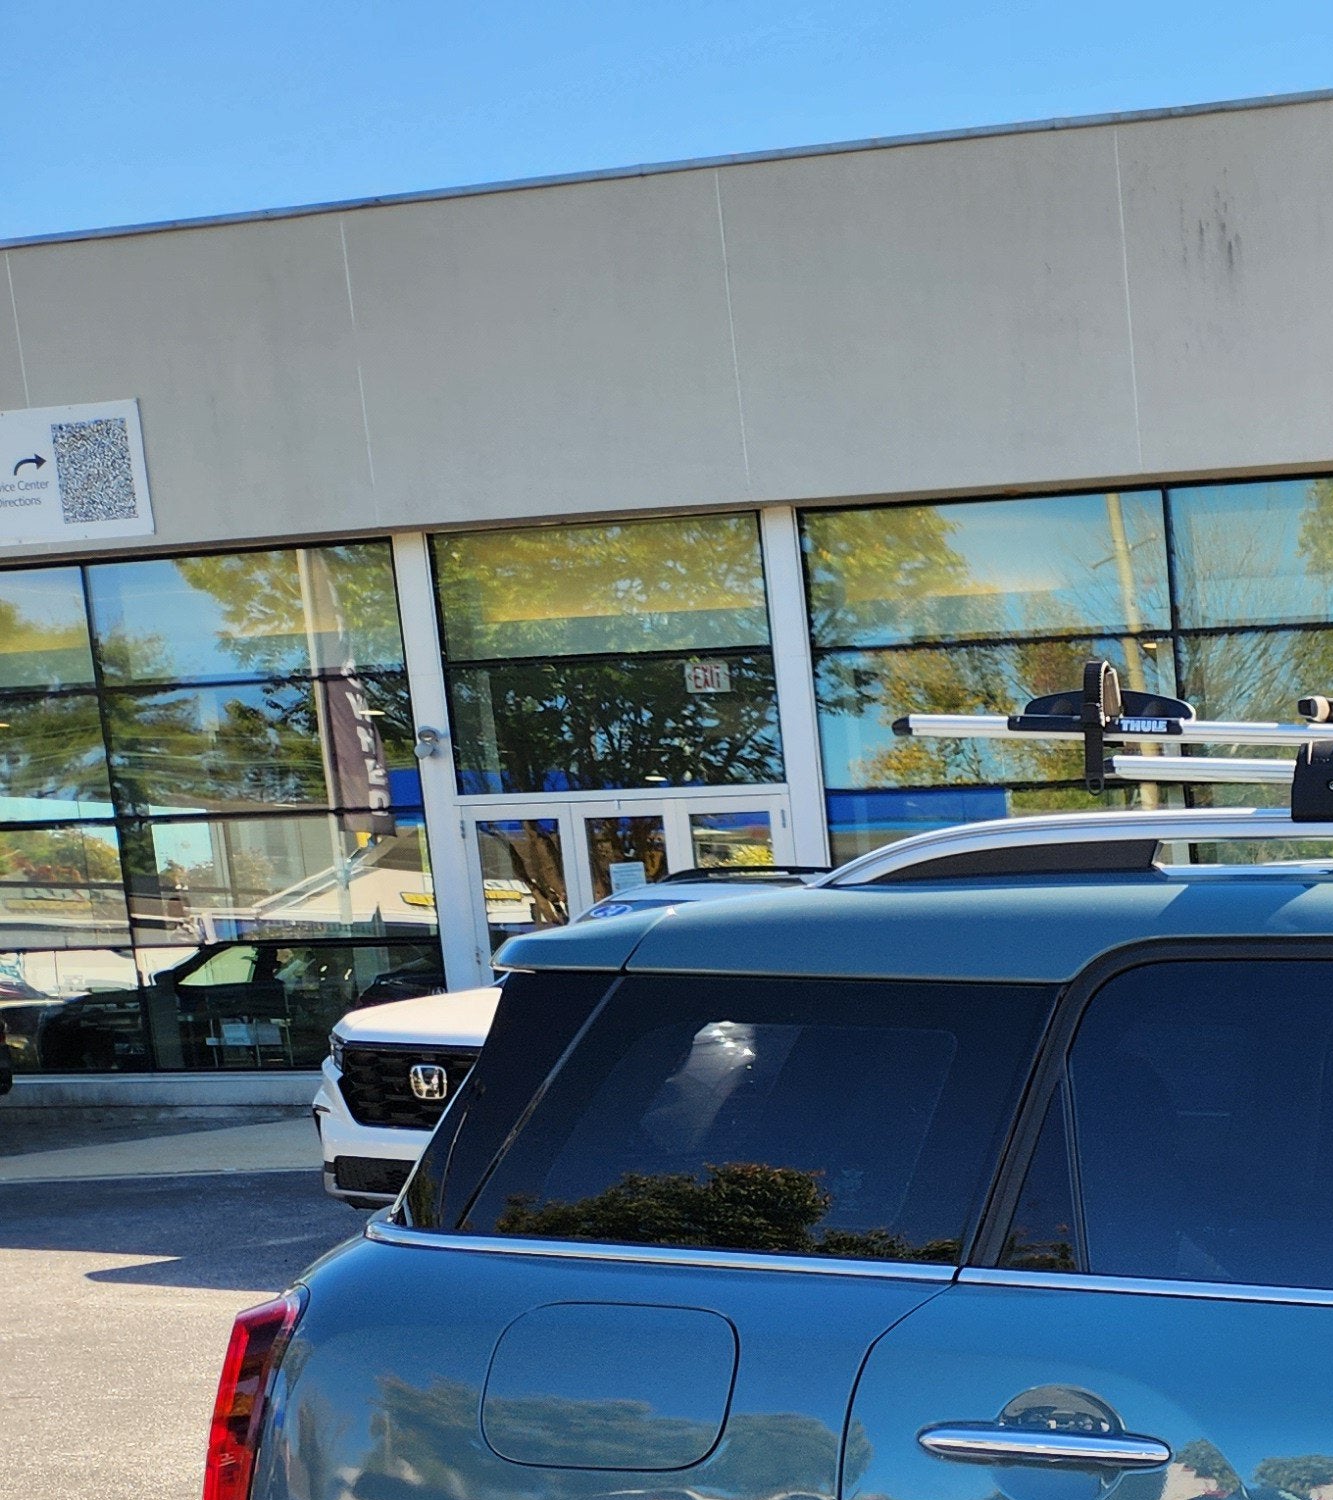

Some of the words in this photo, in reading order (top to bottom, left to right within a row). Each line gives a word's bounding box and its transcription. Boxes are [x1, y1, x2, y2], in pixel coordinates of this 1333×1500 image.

[17, 480, 49, 491] Center
[693, 664, 721, 689] EXIT
[1120, 719, 1168, 732] THULE
